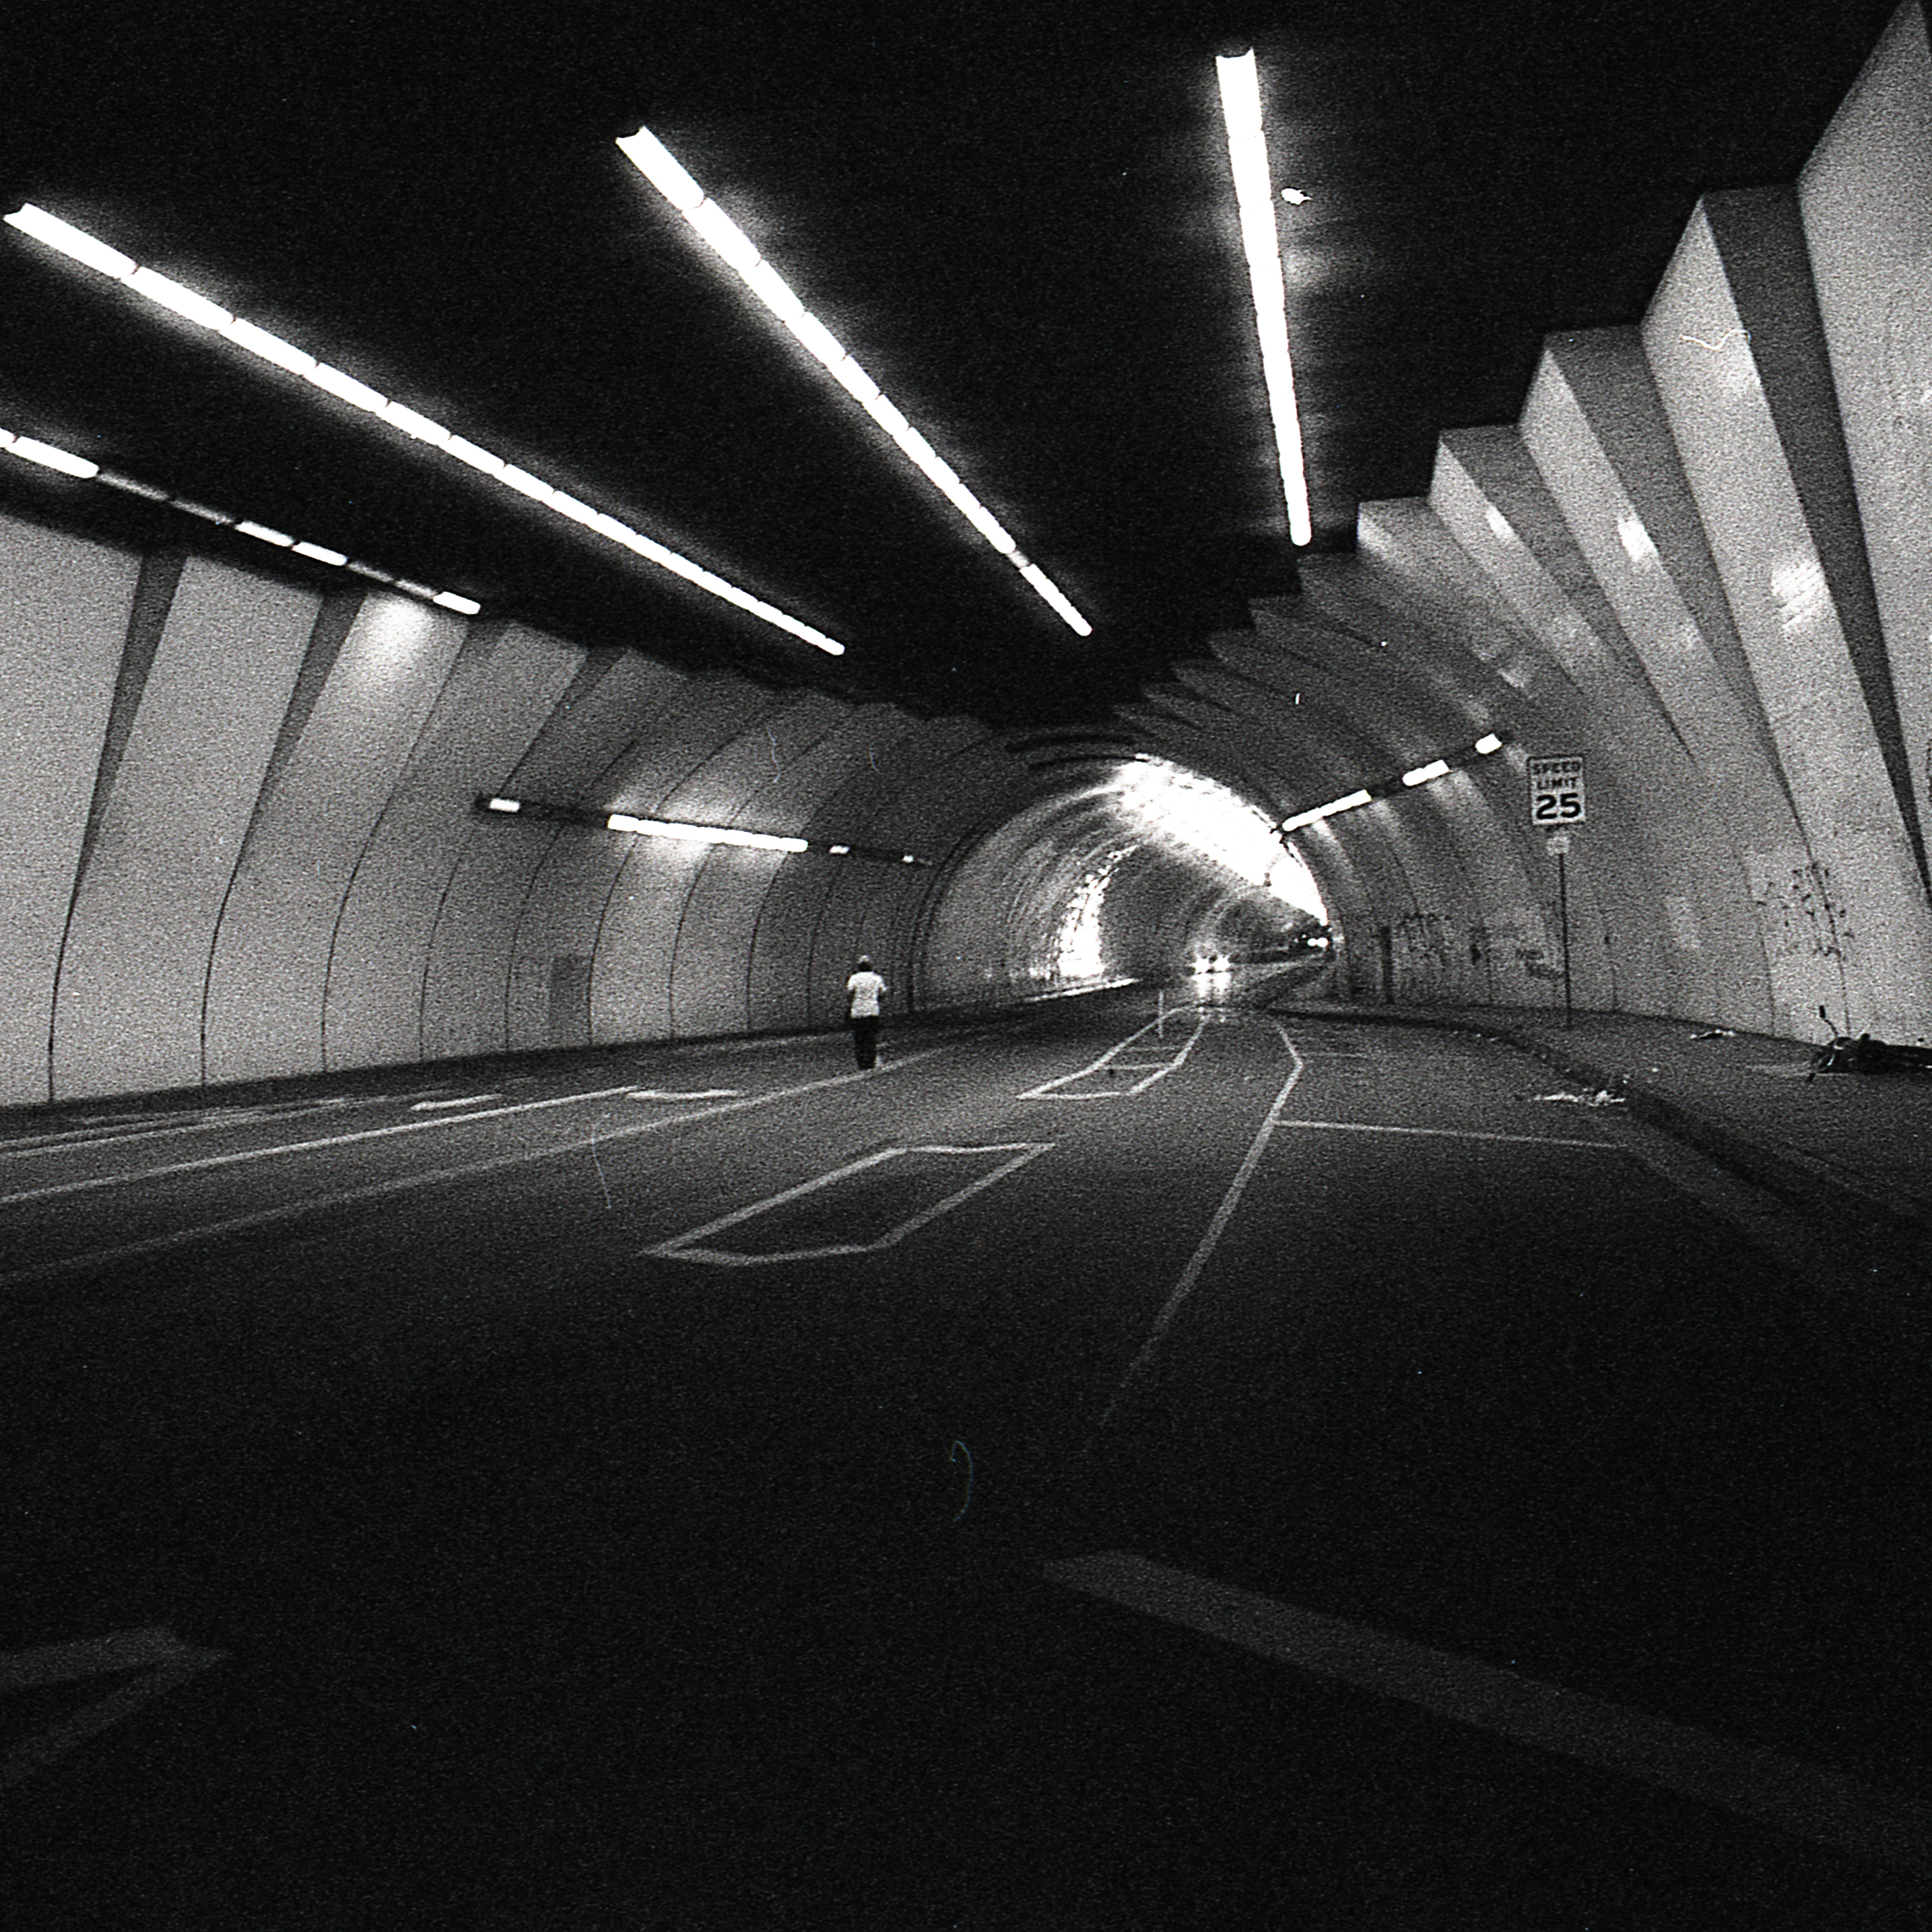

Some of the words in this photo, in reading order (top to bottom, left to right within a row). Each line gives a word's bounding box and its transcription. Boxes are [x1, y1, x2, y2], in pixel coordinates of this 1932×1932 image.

[1533, 762, 1580, 774] SPEED
[1537, 777, 1577, 789] LIMIT
[1537, 793, 1580, 820] 25
